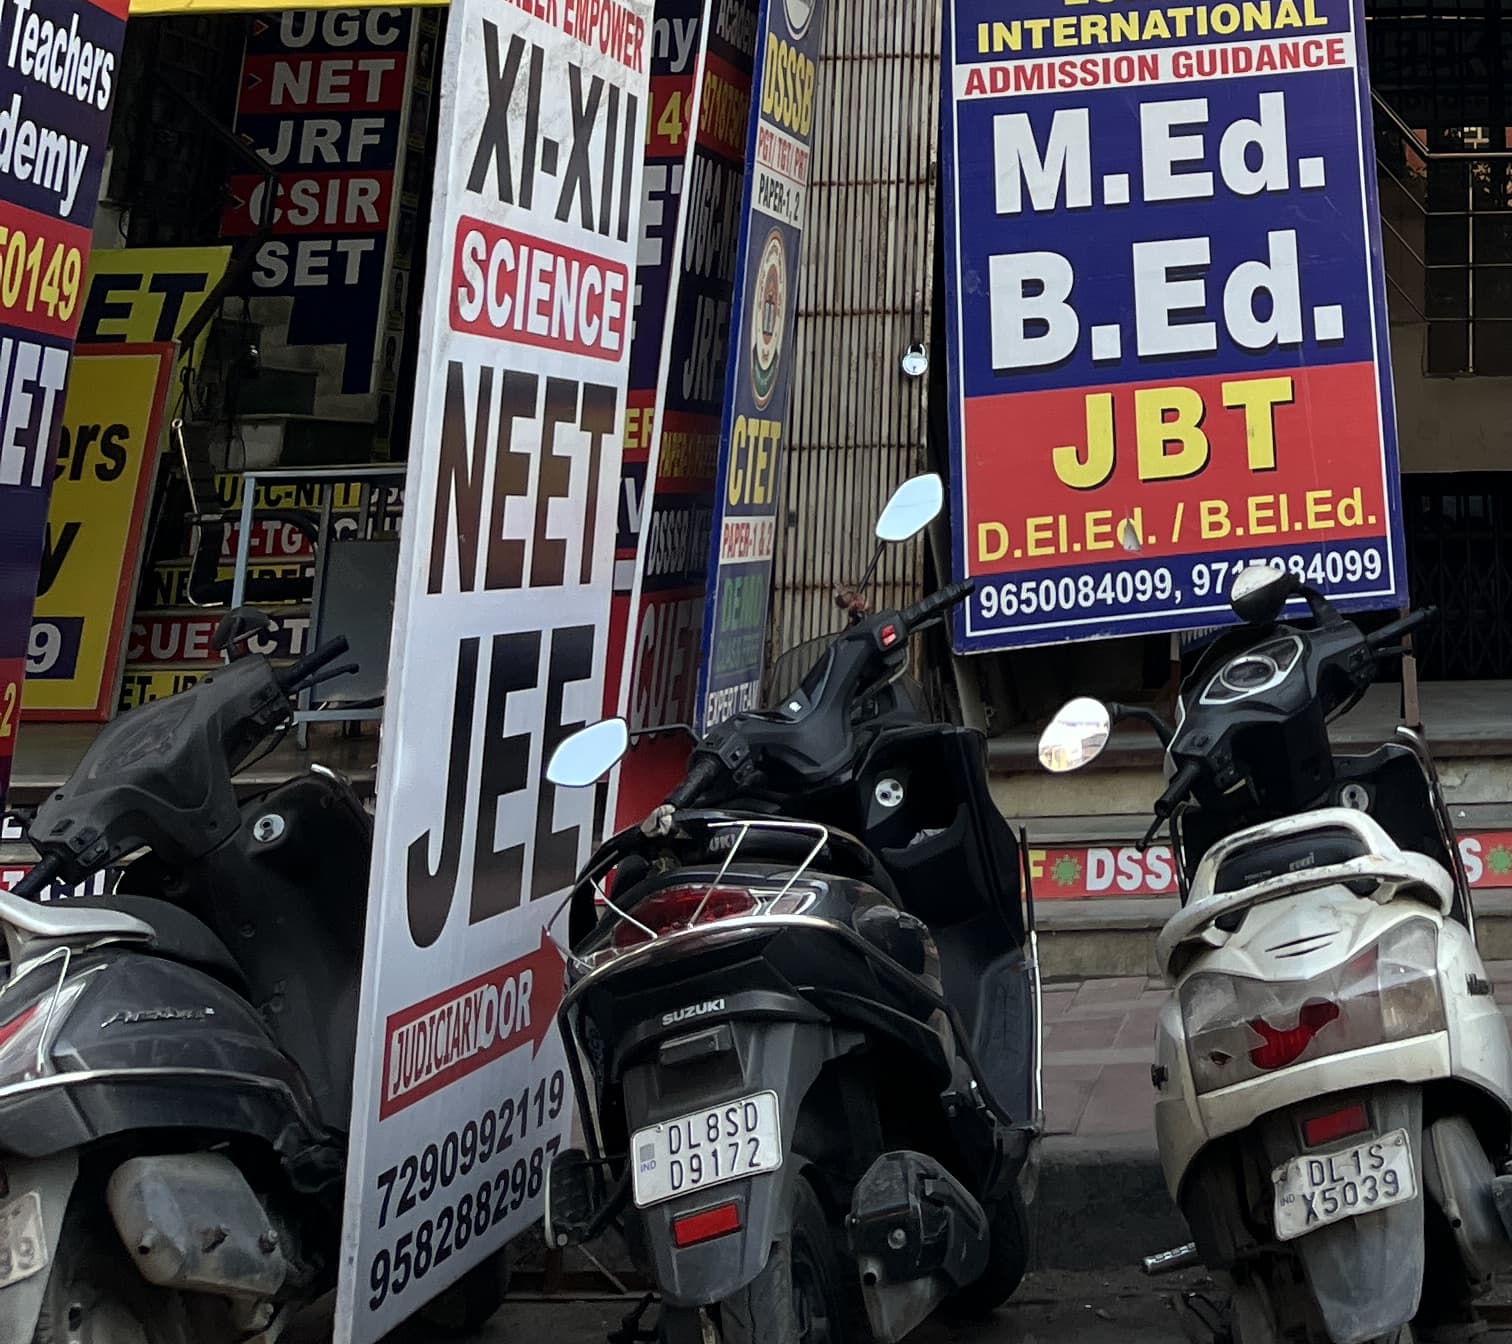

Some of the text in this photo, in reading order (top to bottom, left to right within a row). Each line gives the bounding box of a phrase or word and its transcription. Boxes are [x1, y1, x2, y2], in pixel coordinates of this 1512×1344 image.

[270, 59, 395, 105] NET
[763, 32, 815, 136] DSSSB
[964, 37, 1346, 96] ADMISSION GUIDANCE
[256, 119, 385, 166] JRF
[467, 17, 638, 243] XI-XII
[992, 91, 1327, 214] M.Ed.
[252, 239, 375, 287] SET
[458, 230, 624, 351] SCIENCE
[988, 230, 1346, 369] B.Ed.
[427, 359, 617, 596] NEET
[729, 416, 781, 506] CTET
[1052, 377, 1294, 491] JBT
[1201, 487, 1377, 540] B.El.Ed.
[407, 625, 595, 949] JEE
[661, 999, 725, 1026] SUZUKI
[376, 1069, 565, 1231] 7290992119
[668, 1102, 758, 1155] DL8SD
[671, 1139, 761, 1191] D9172
[1303, 1169, 1399, 1225] X5039
